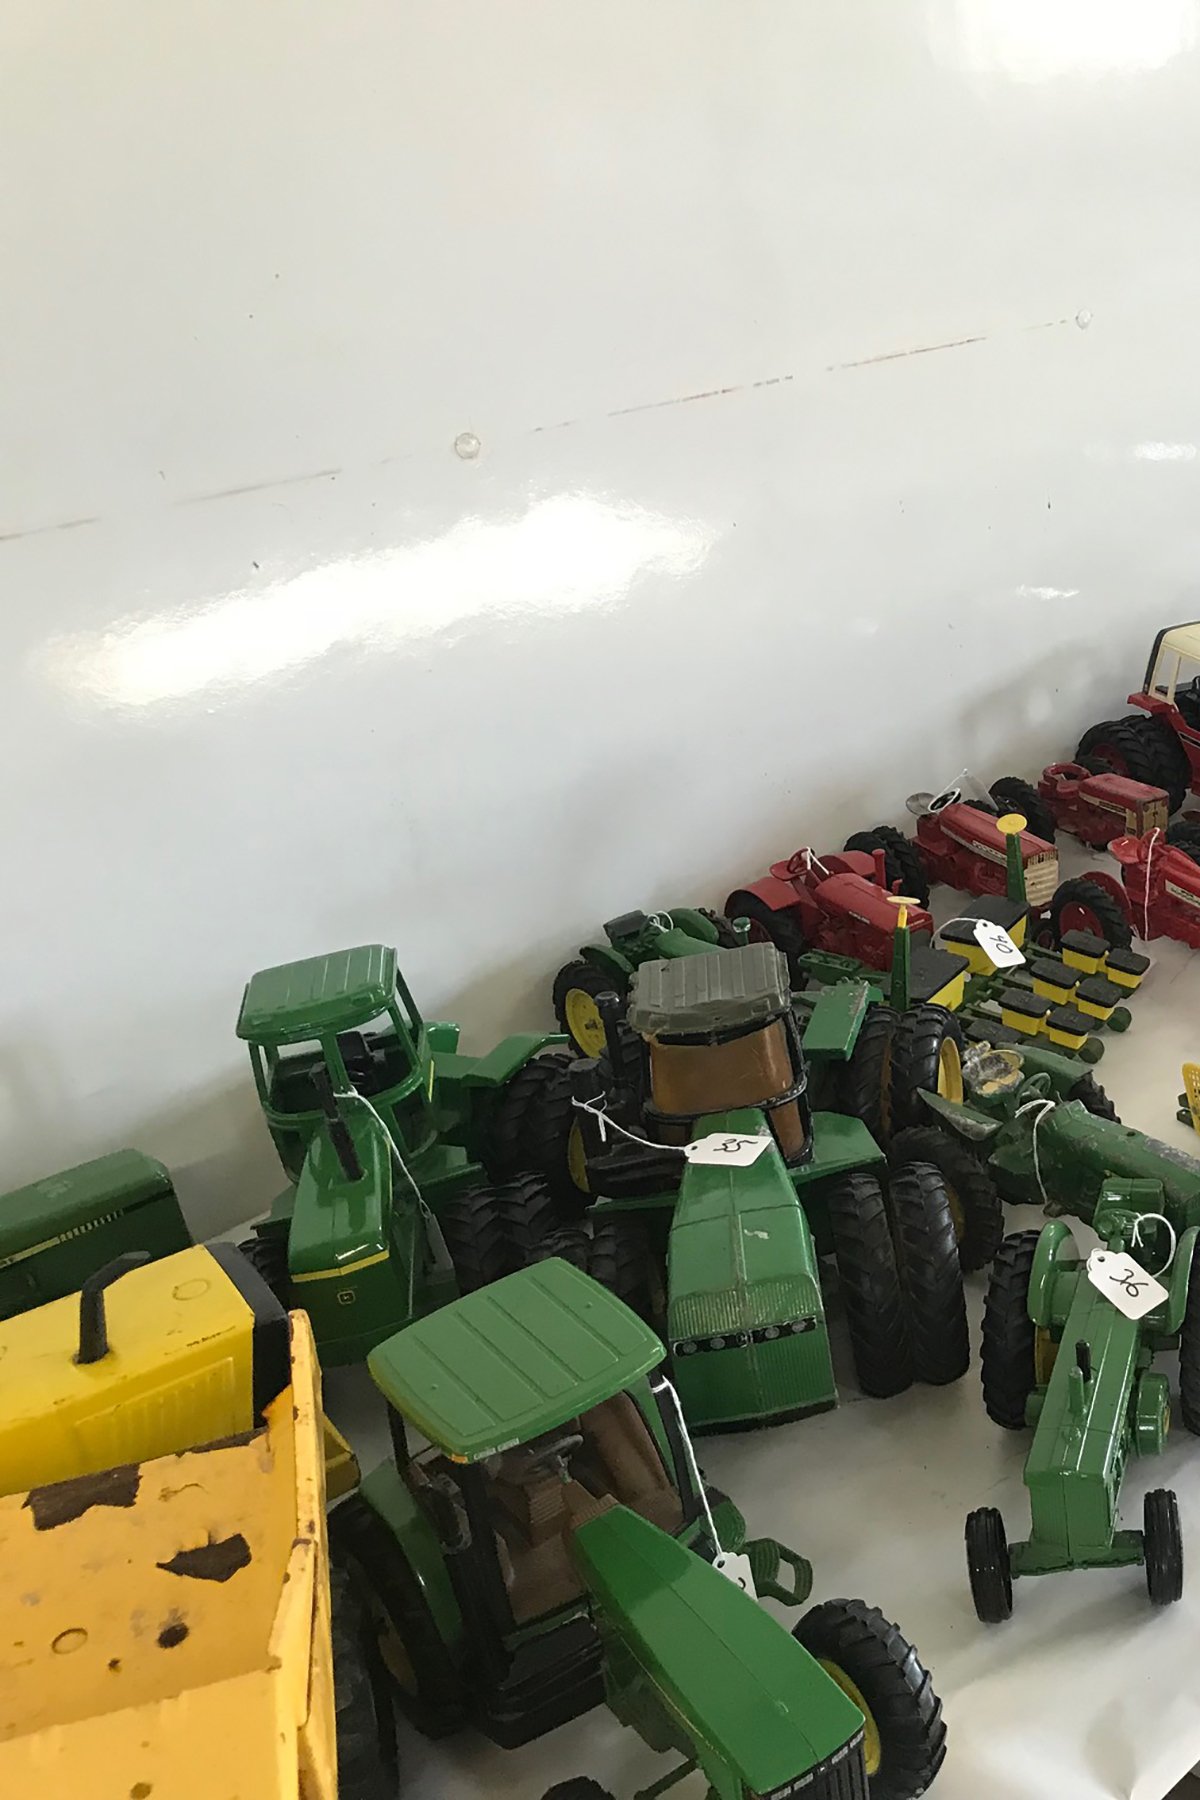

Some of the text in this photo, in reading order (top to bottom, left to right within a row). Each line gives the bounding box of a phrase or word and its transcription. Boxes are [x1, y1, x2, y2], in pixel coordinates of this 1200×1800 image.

[989, 935, 1014, 954] 40
[713, 1138, 758, 1152] 35
[1109, 1268, 1149, 1297] 36
